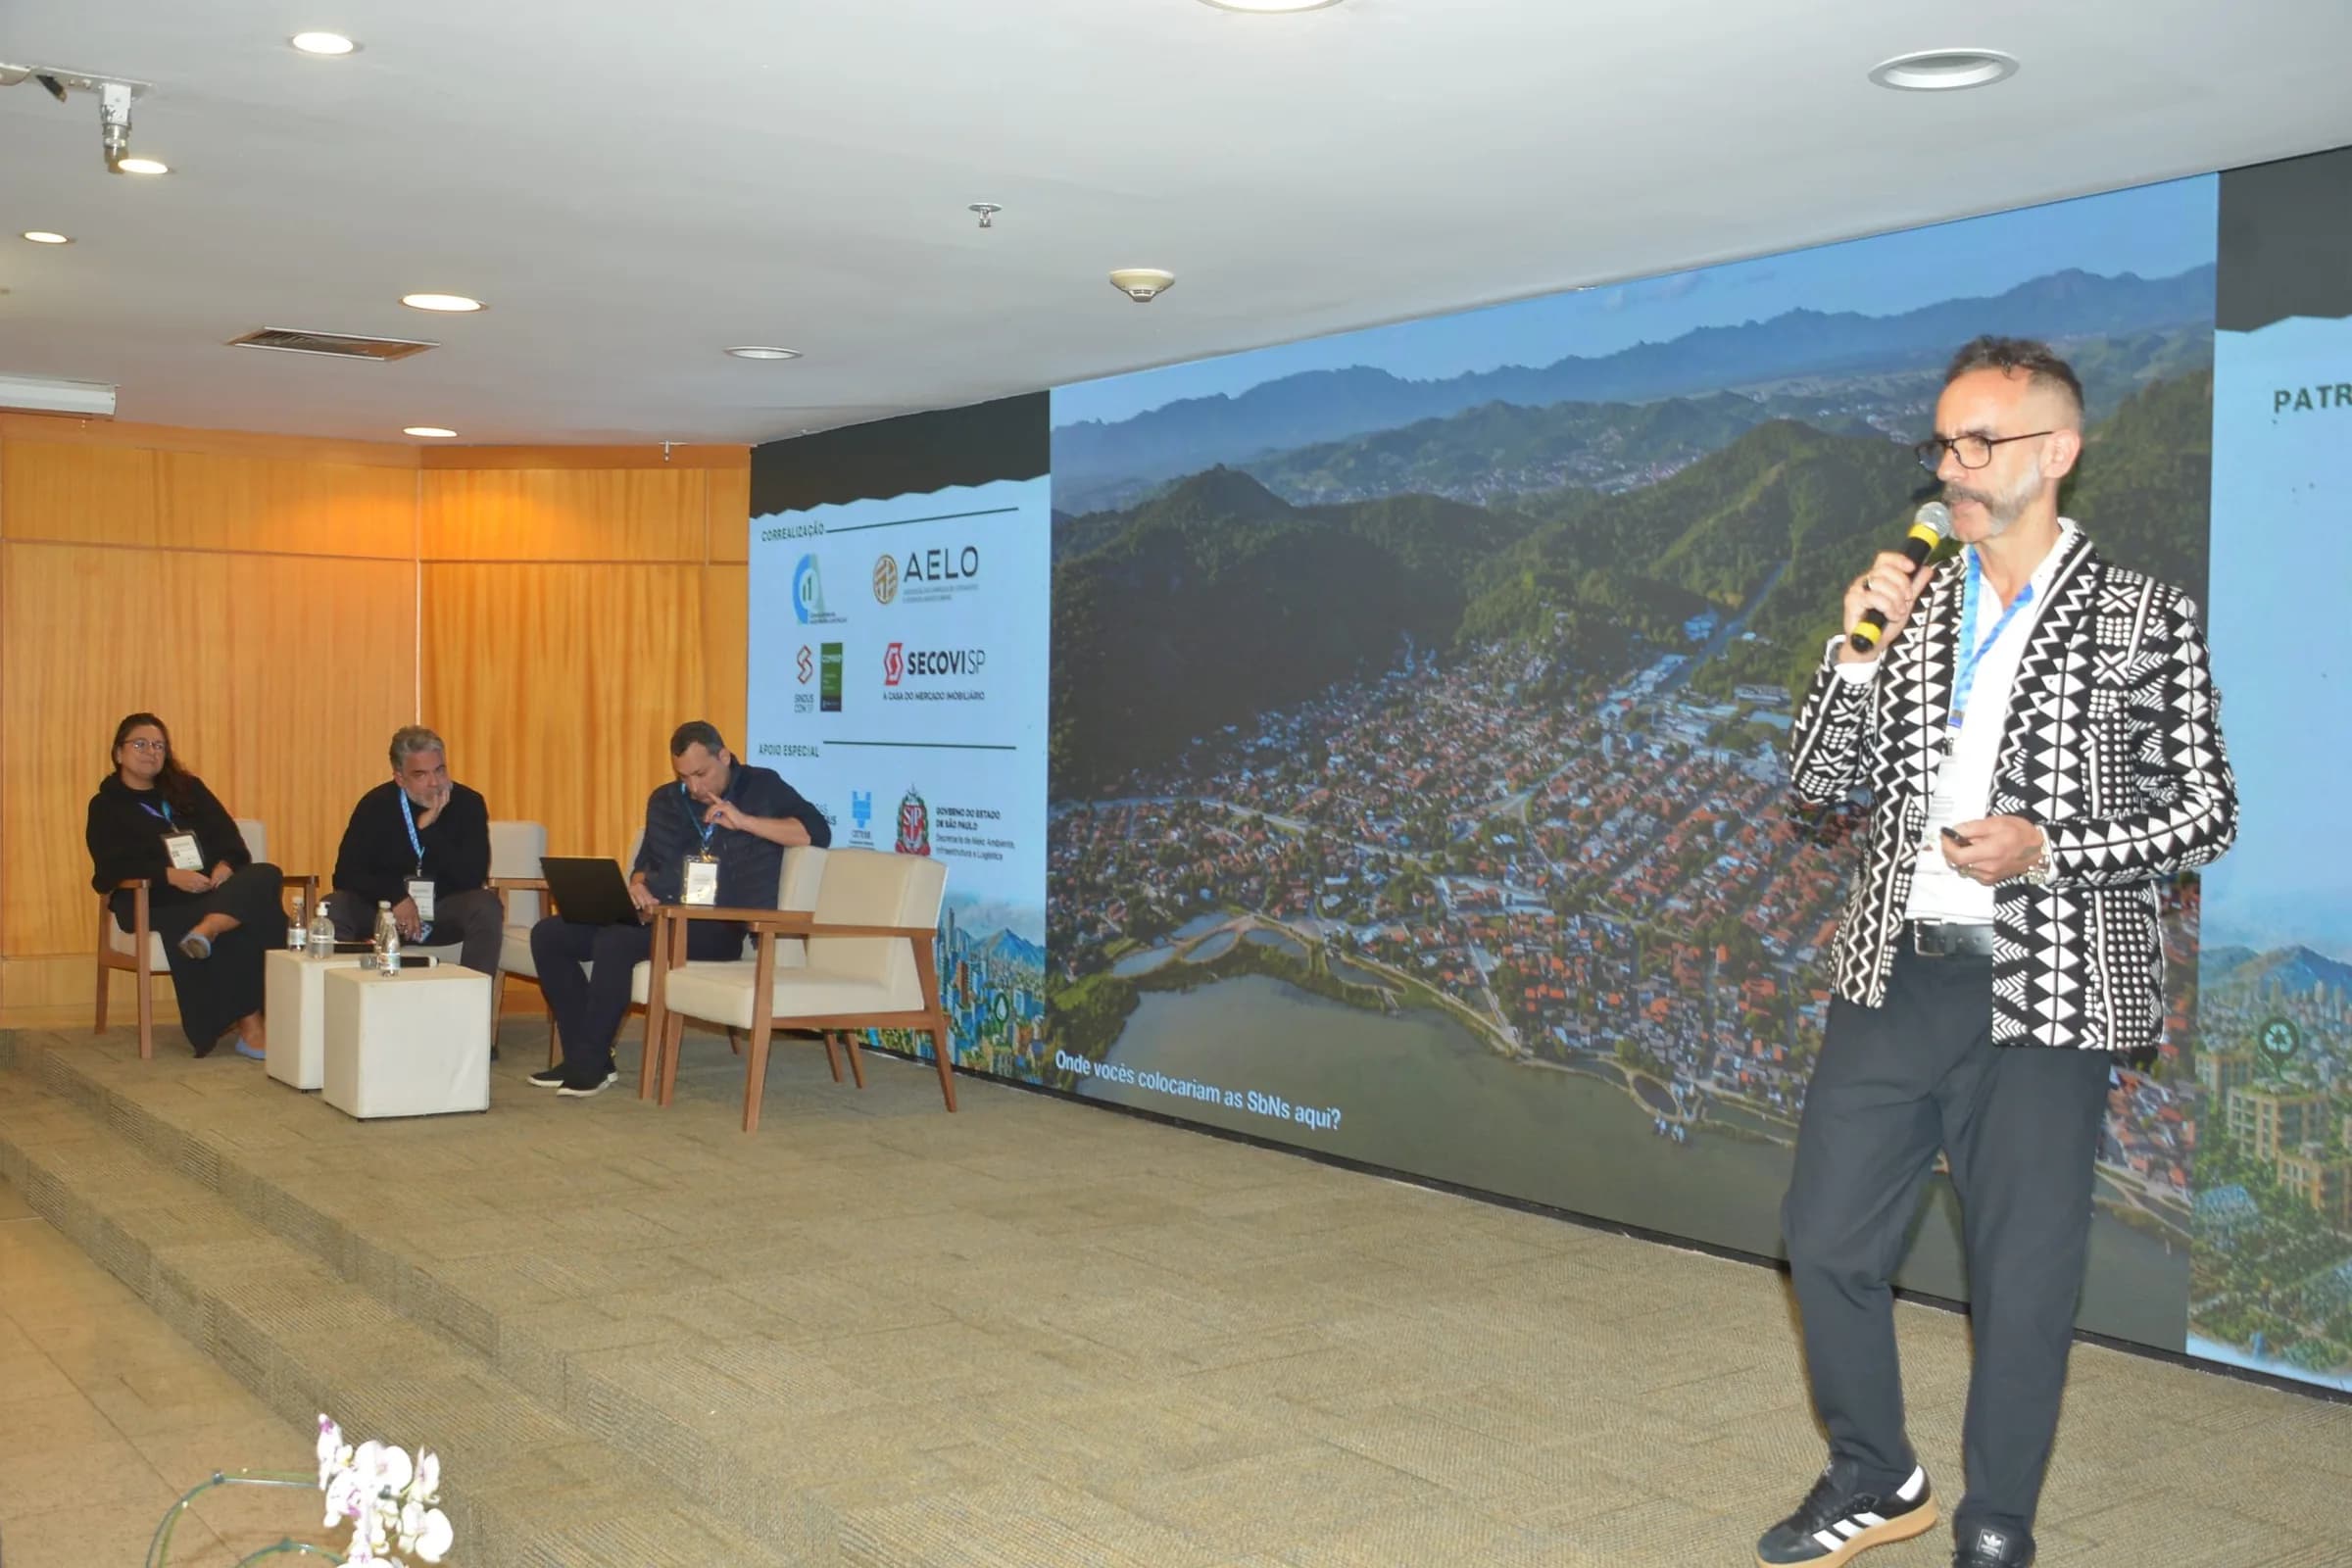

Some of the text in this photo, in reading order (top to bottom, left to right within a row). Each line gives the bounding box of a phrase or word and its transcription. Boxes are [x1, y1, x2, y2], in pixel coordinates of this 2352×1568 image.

[904, 546, 979, 583] AELO
[759, 744, 819, 758] APOIO ESPECIAL
[1054, 1050, 1091, 1076] Onde
[1138, 1071, 1220, 1103] colocariam
[1224, 1092, 1243, 1109] as
[1248, 1089, 1290, 1120] SbNs
[1295, 1104, 1342, 1132] aqui?
